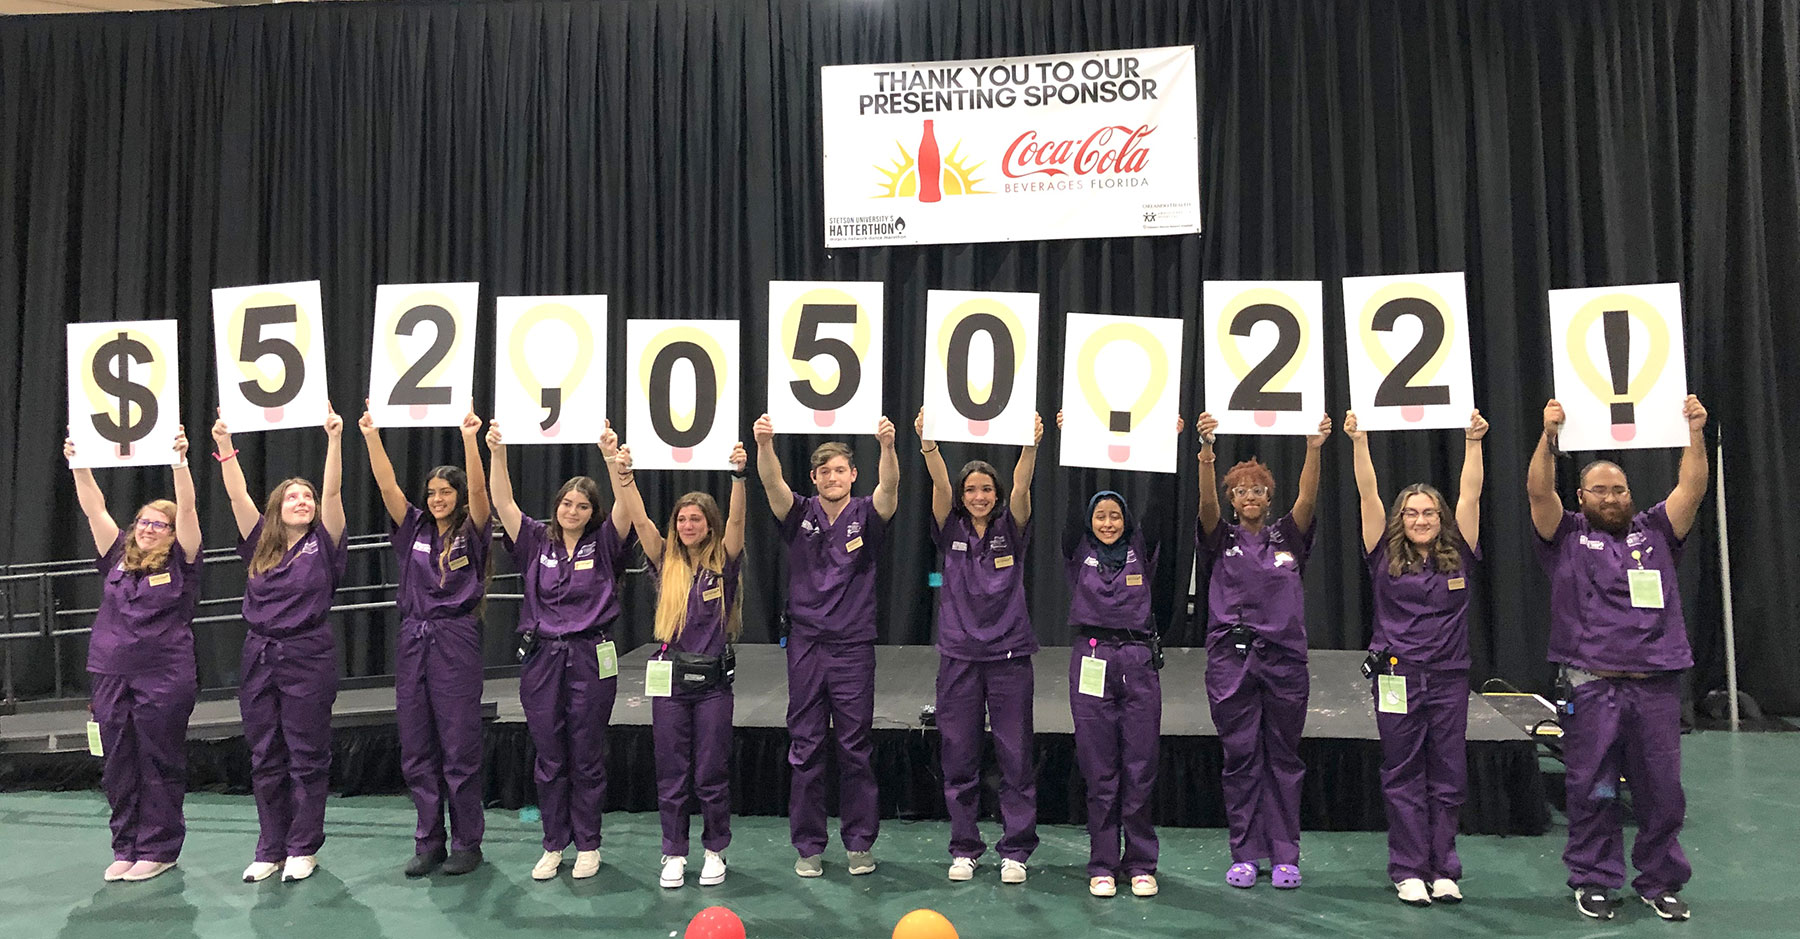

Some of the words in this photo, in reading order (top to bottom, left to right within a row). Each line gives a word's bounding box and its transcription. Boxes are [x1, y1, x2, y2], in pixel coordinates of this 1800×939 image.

[859, 87, 1017, 116] PRESENTING
[1023, 79, 1158, 107] SPONSOR
[874, 67, 963, 92] THANK
[969, 64, 1029, 87] YOU
[1035, 60, 1075, 84] TO
[1081, 57, 1140, 80] OUR
[1001, 124, 1158, 179] Coca-Cola
[1004, 180, 1083, 193] BEVERAGES
[1091, 177, 1149, 189] FLORIDA
[829, 223, 894, 237] HATTERTHON
[856, 215, 894, 223] UNIVERSITYS
[91, 333, 158, 455] $
[239, 305, 304, 407] 5
[388, 305, 456, 405] 2
[649, 342, 716, 447] 0
[790, 304, 860, 410] 5
[947, 314, 1014, 421] 0
[1229, 304, 1302, 411] 2
[1372, 298, 1450, 406] 2
[1603, 311, 1634, 424] !
